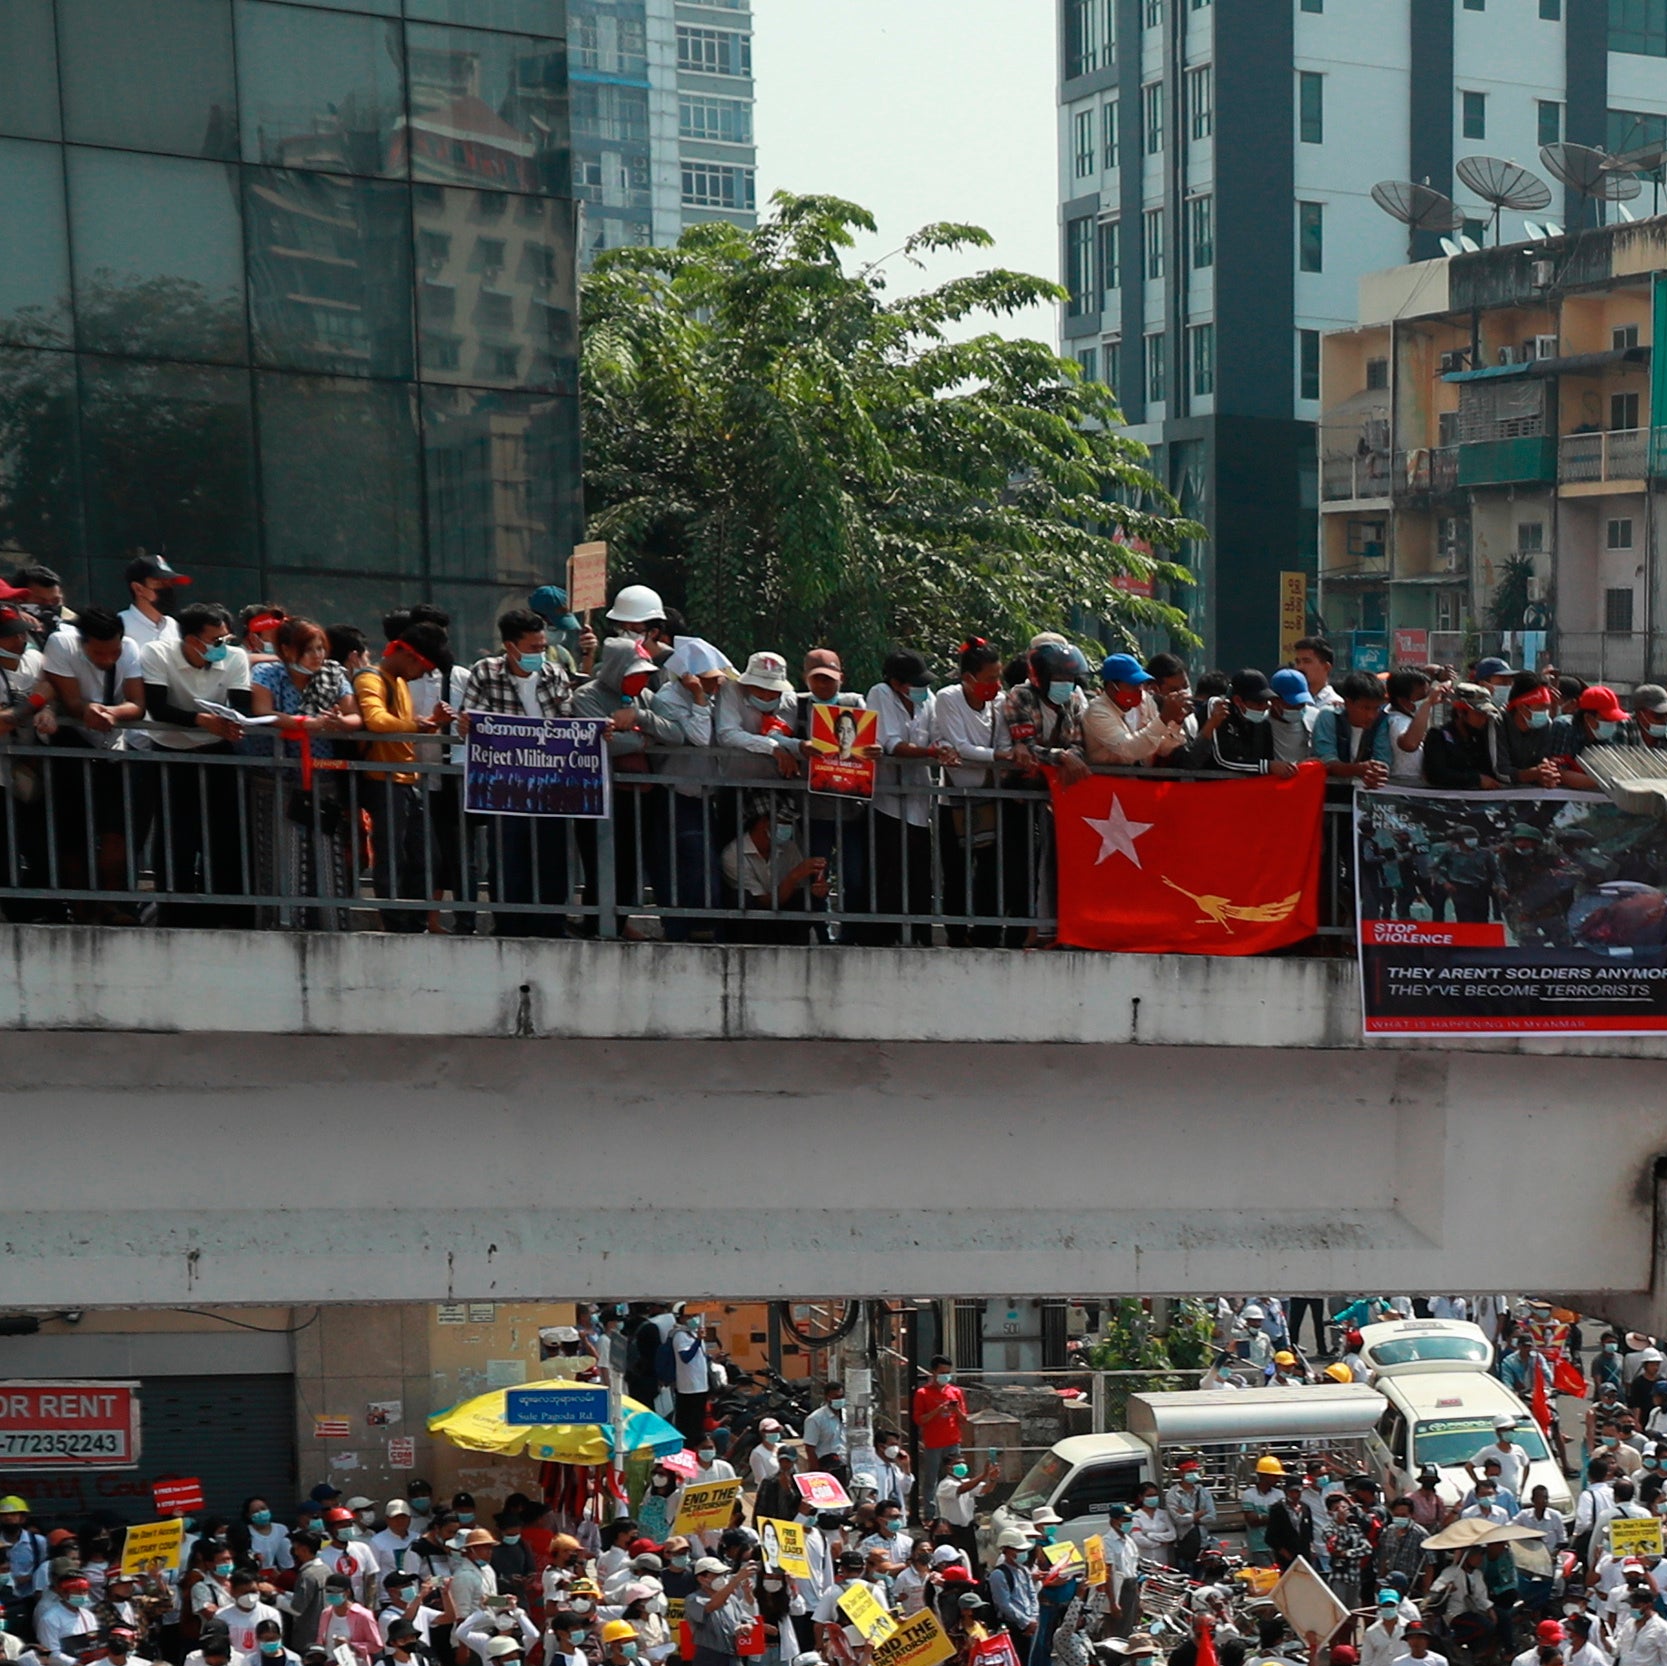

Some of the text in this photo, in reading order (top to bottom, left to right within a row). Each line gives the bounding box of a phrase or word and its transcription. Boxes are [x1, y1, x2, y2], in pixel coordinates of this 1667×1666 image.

[471, 744, 599, 773] Reject Military Coup
[1374, 923, 1418, 934] STOP
[1374, 933, 1454, 946] VIOLENCE
[1387, 966, 1436, 980] THEY
[1438, 967, 1501, 980] AREN'T
[1505, 967, 1592, 980] SOLDIERS
[1388, 984, 1651, 997] THEY'VE BECOME TERRORISTS
[1431, 1020, 1504, 1030] HAPPENING
[40, 1394, 118, 1419] RENT
[517, 1412, 596, 1422] Sule Pagoda Rd.
[683, 1486, 736, 1506] END THE
[682, 1499, 734, 1515] DICTATORSHIP
[127, 1541, 178, 1555] MILITARY COUP
[872, 1618, 937, 1661] END THE
